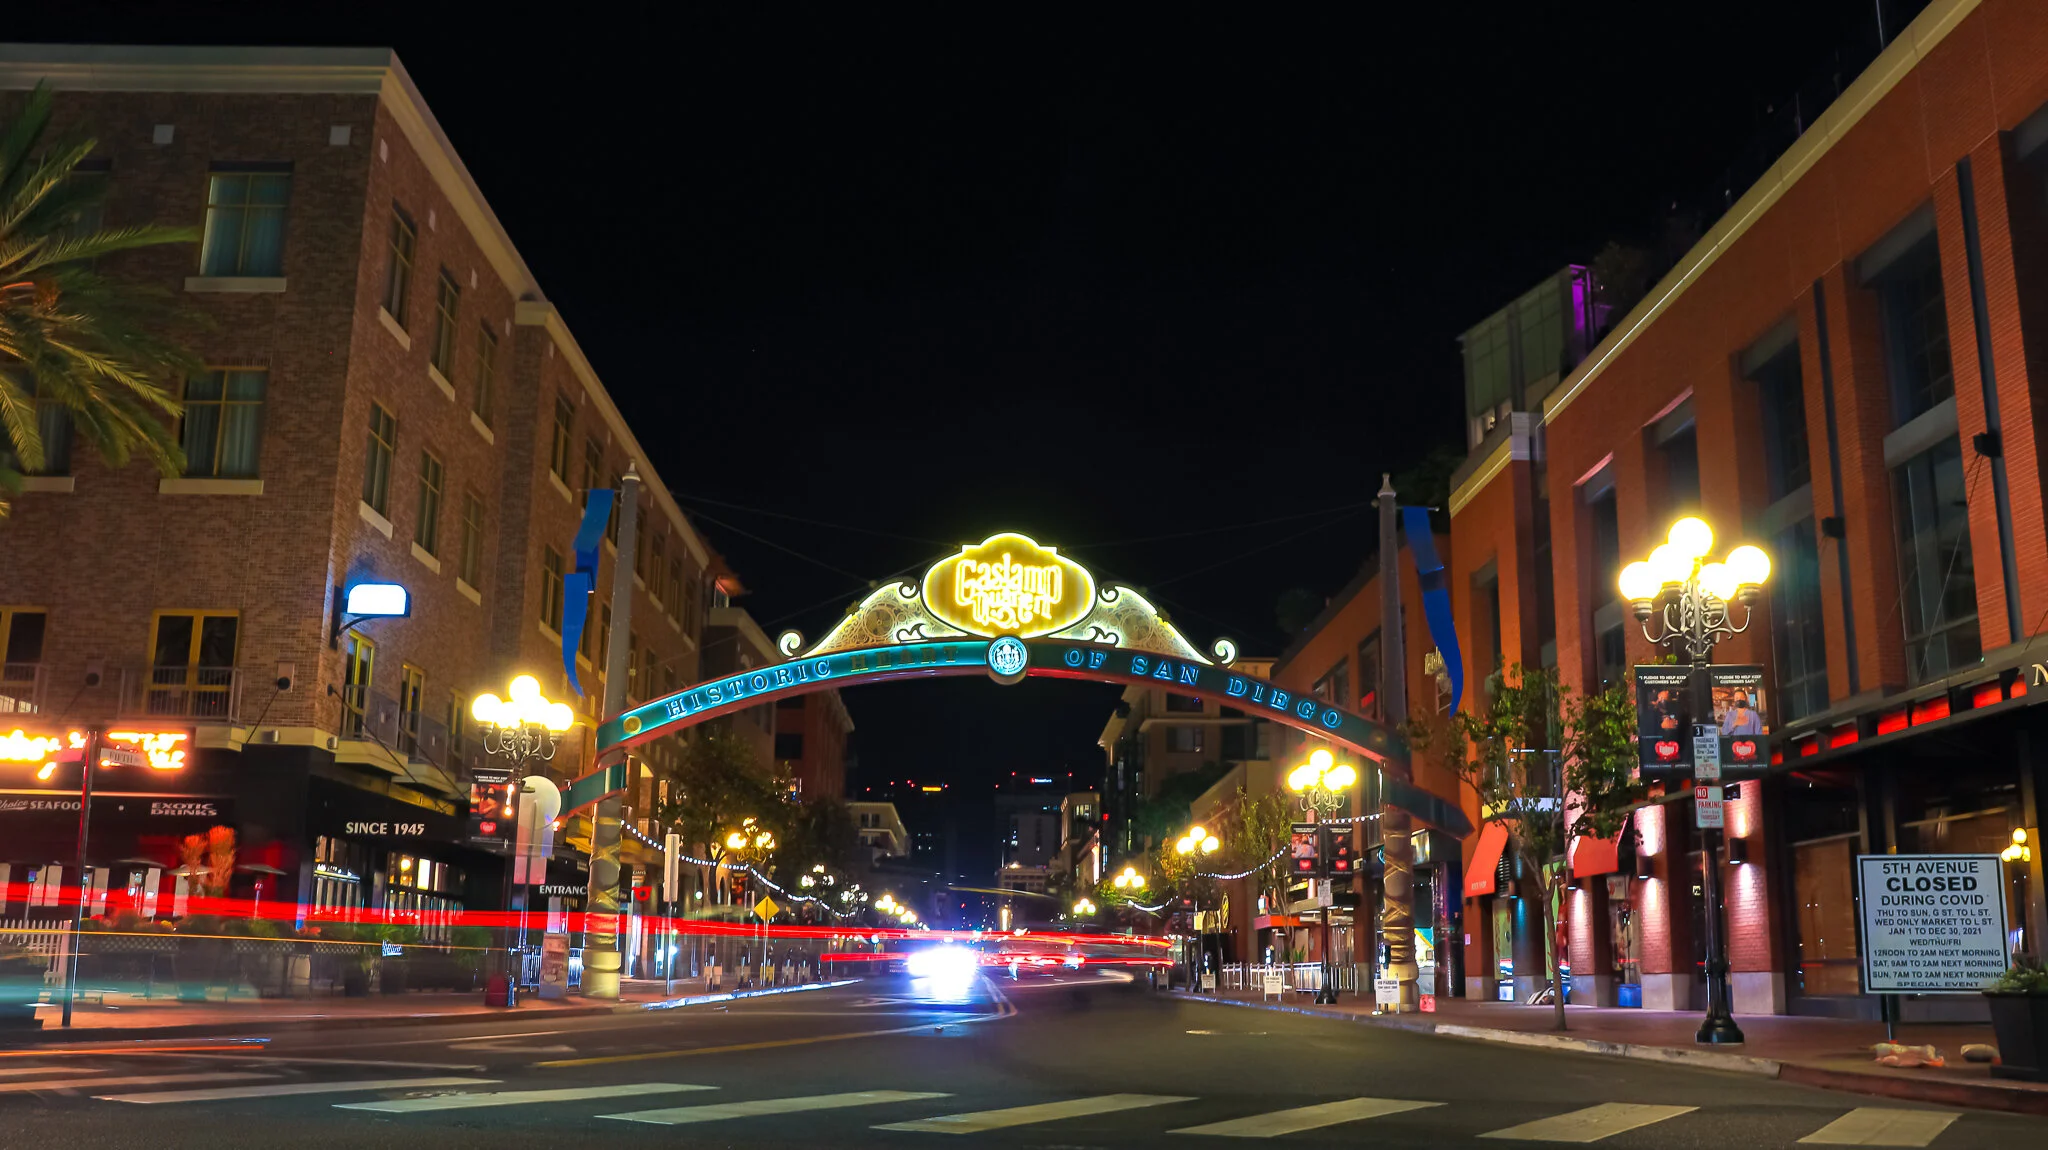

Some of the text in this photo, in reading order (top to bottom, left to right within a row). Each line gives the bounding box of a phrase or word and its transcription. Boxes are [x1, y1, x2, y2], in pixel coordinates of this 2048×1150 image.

[955, 552, 1063, 607] Gaslamp
[666, 660, 831, 719] HISTORIC
[851, 646, 958, 672] HEART
[1064, 649, 1107, 669] OF
[1131, 655, 1199, 685] SAN
[1226, 676, 1343, 729] DIEGO
[1697, 788, 1707, 798] NO
[30, 801, 82, 811] SEAFOO
[151, 802, 214, 810] EXOTIC
[1698, 801, 1722, 809] PARKING
[345, 821, 425, 835] SINCE 1945
[1883, 862, 1979, 874] 5TH AVENUE
[540, 884, 587, 895] ENTRANC
[1887, 877, 1977, 891] CLOSED
[1881, 895, 1983, 906] DURING COVID
[1897, 918, 1919, 926] ONLY
